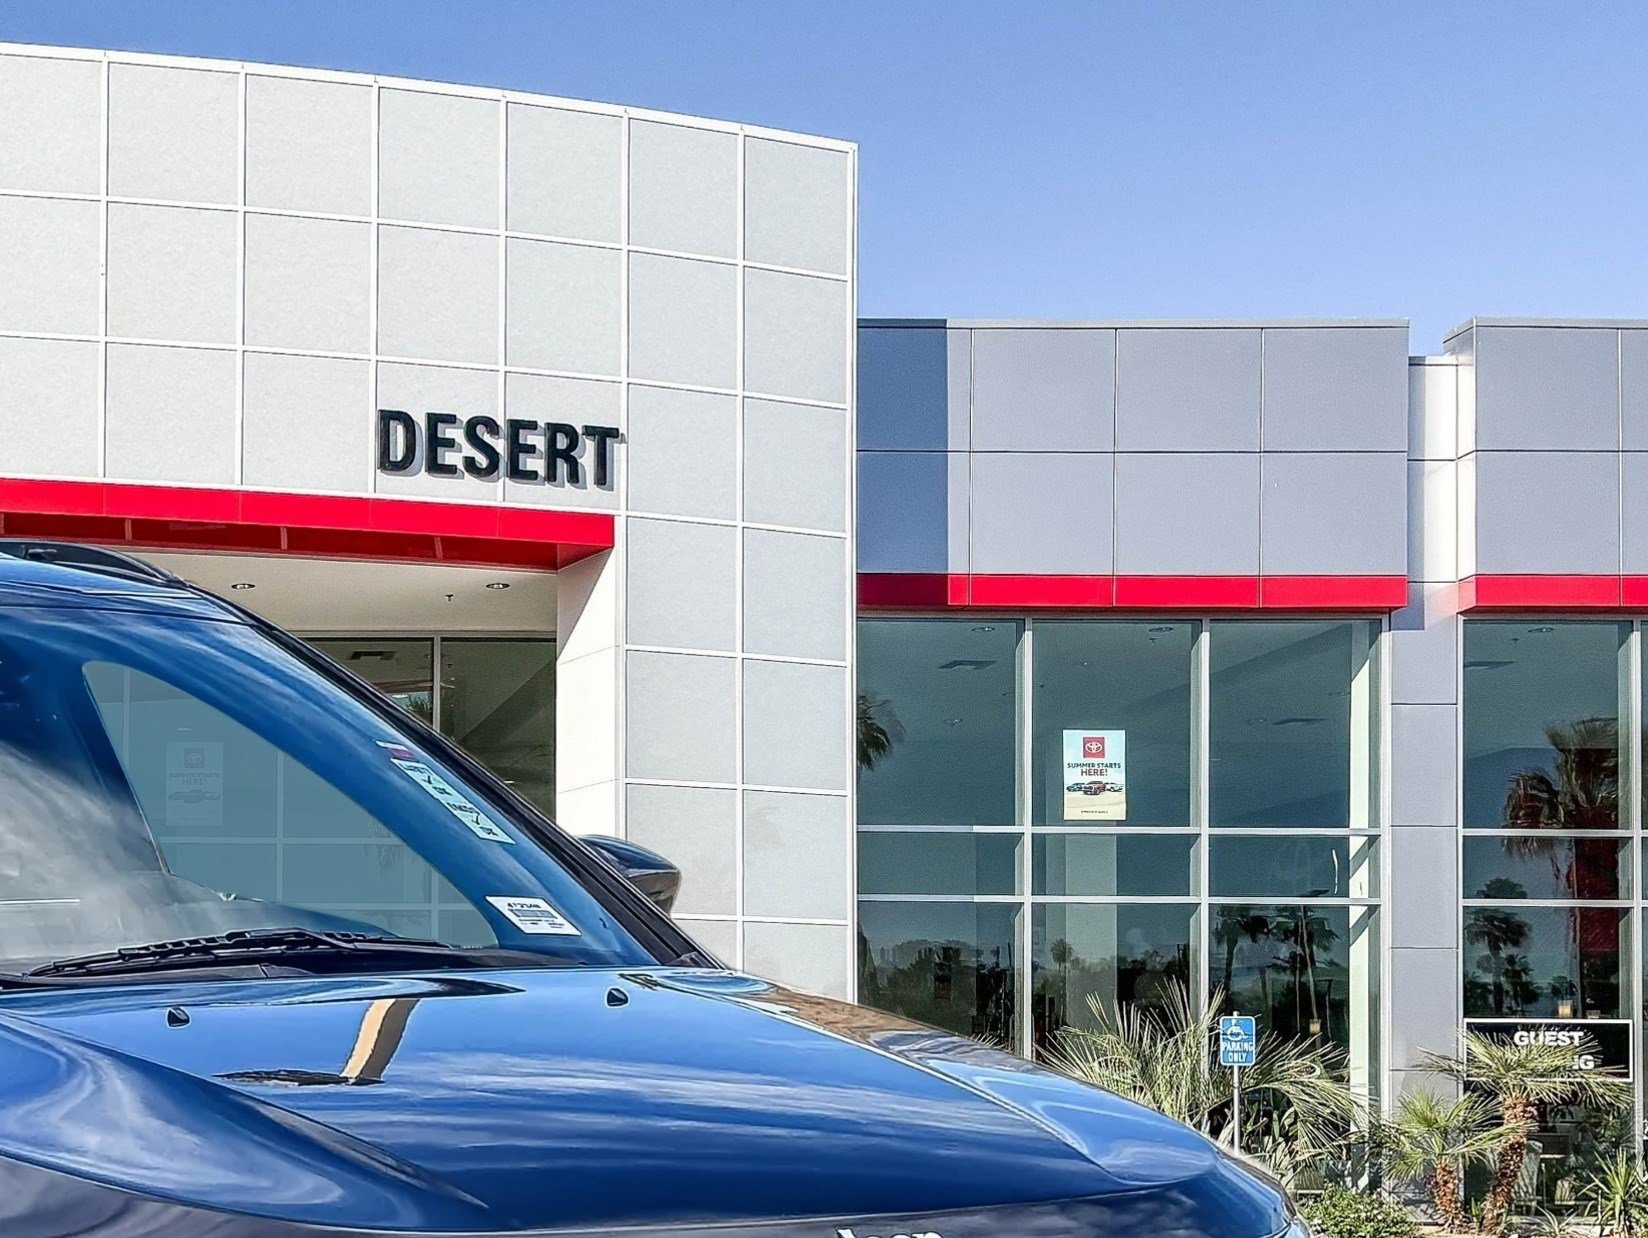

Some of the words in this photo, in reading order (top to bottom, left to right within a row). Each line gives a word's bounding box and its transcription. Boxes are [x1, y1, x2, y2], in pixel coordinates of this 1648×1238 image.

[377, 409, 620, 487] DESERT
[1080, 768, 1108, 776] HERE!
[1513, 1030, 1585, 1047] GUEST
[1222, 1041, 1254, 1052] PARKING
[1228, 1052, 1248, 1062] ONLY
